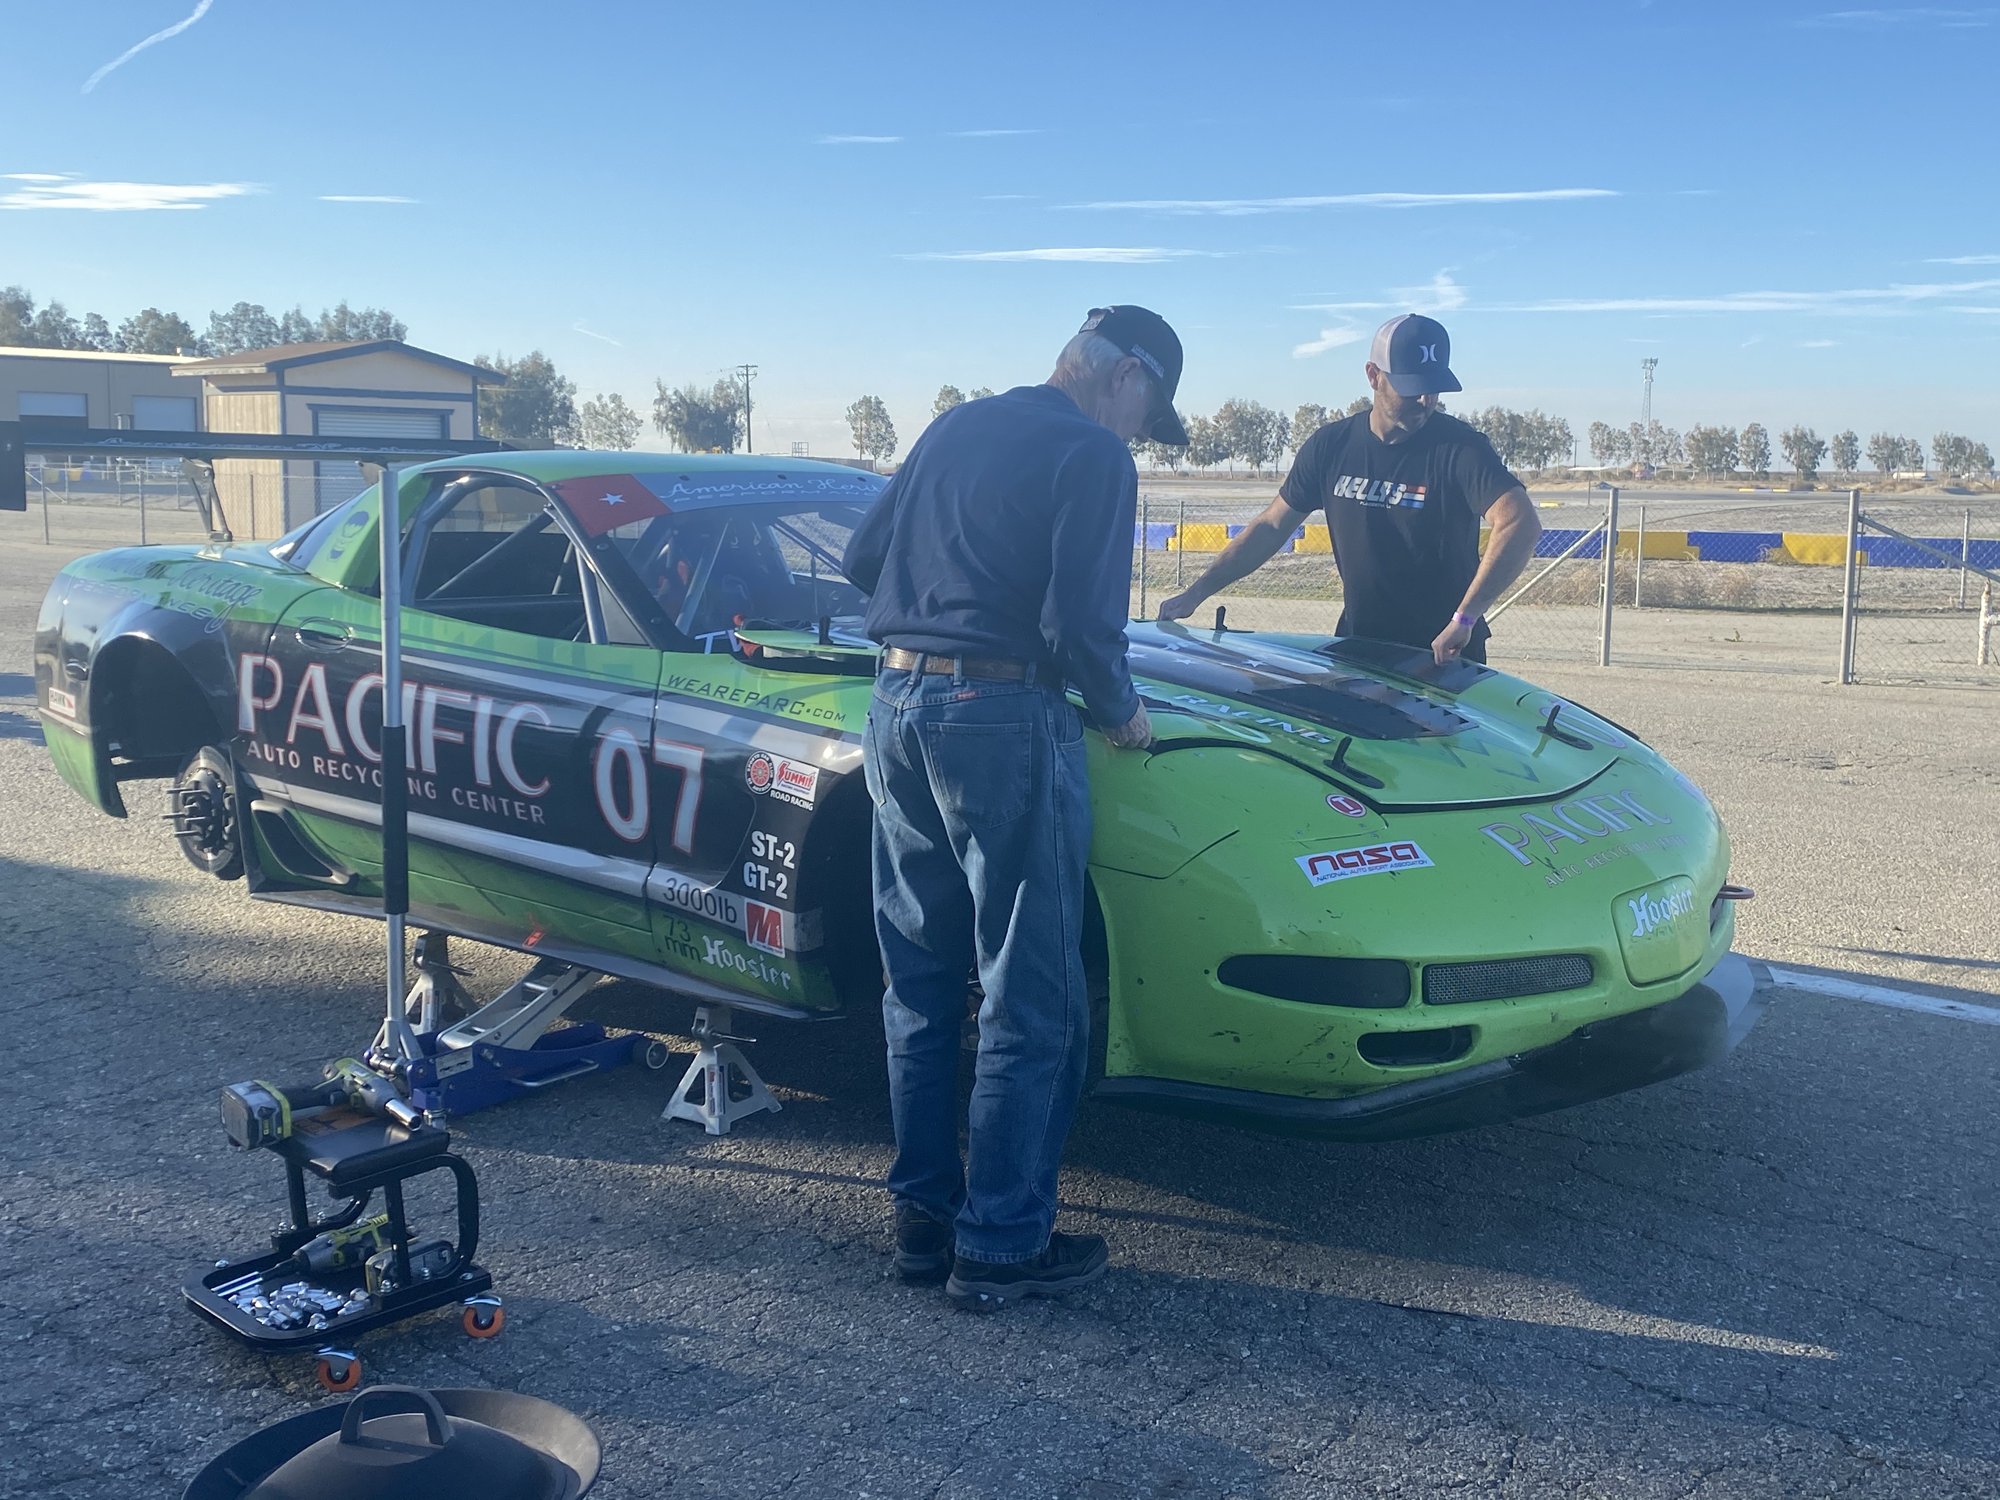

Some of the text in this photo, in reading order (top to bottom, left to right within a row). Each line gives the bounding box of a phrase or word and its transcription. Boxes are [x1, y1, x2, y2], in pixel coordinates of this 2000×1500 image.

[660, 482, 803, 499] American
[238, 653, 550, 798] PACIFIC
[247, 739, 546, 826] AUTO RECYCNG CENTER
[777, 761, 816, 788] SUMMIT
[594, 727, 705, 857] 07
[770, 789, 791, 803] ROAD
[791, 795, 814, 812] RACING
[751, 830, 796, 869] ST-2
[743, 861, 788, 900] GT-2
[1317, 859, 1428, 882] NATIONAL AUTO SPORT ASSOCIATION
[1544, 863, 1583, 889] AUTO
[663, 876, 738, 924] 3000lb
[663, 914, 692, 943] 73
[664, 935, 701, 964] mm
[702, 934, 792, 991] Hoosier
